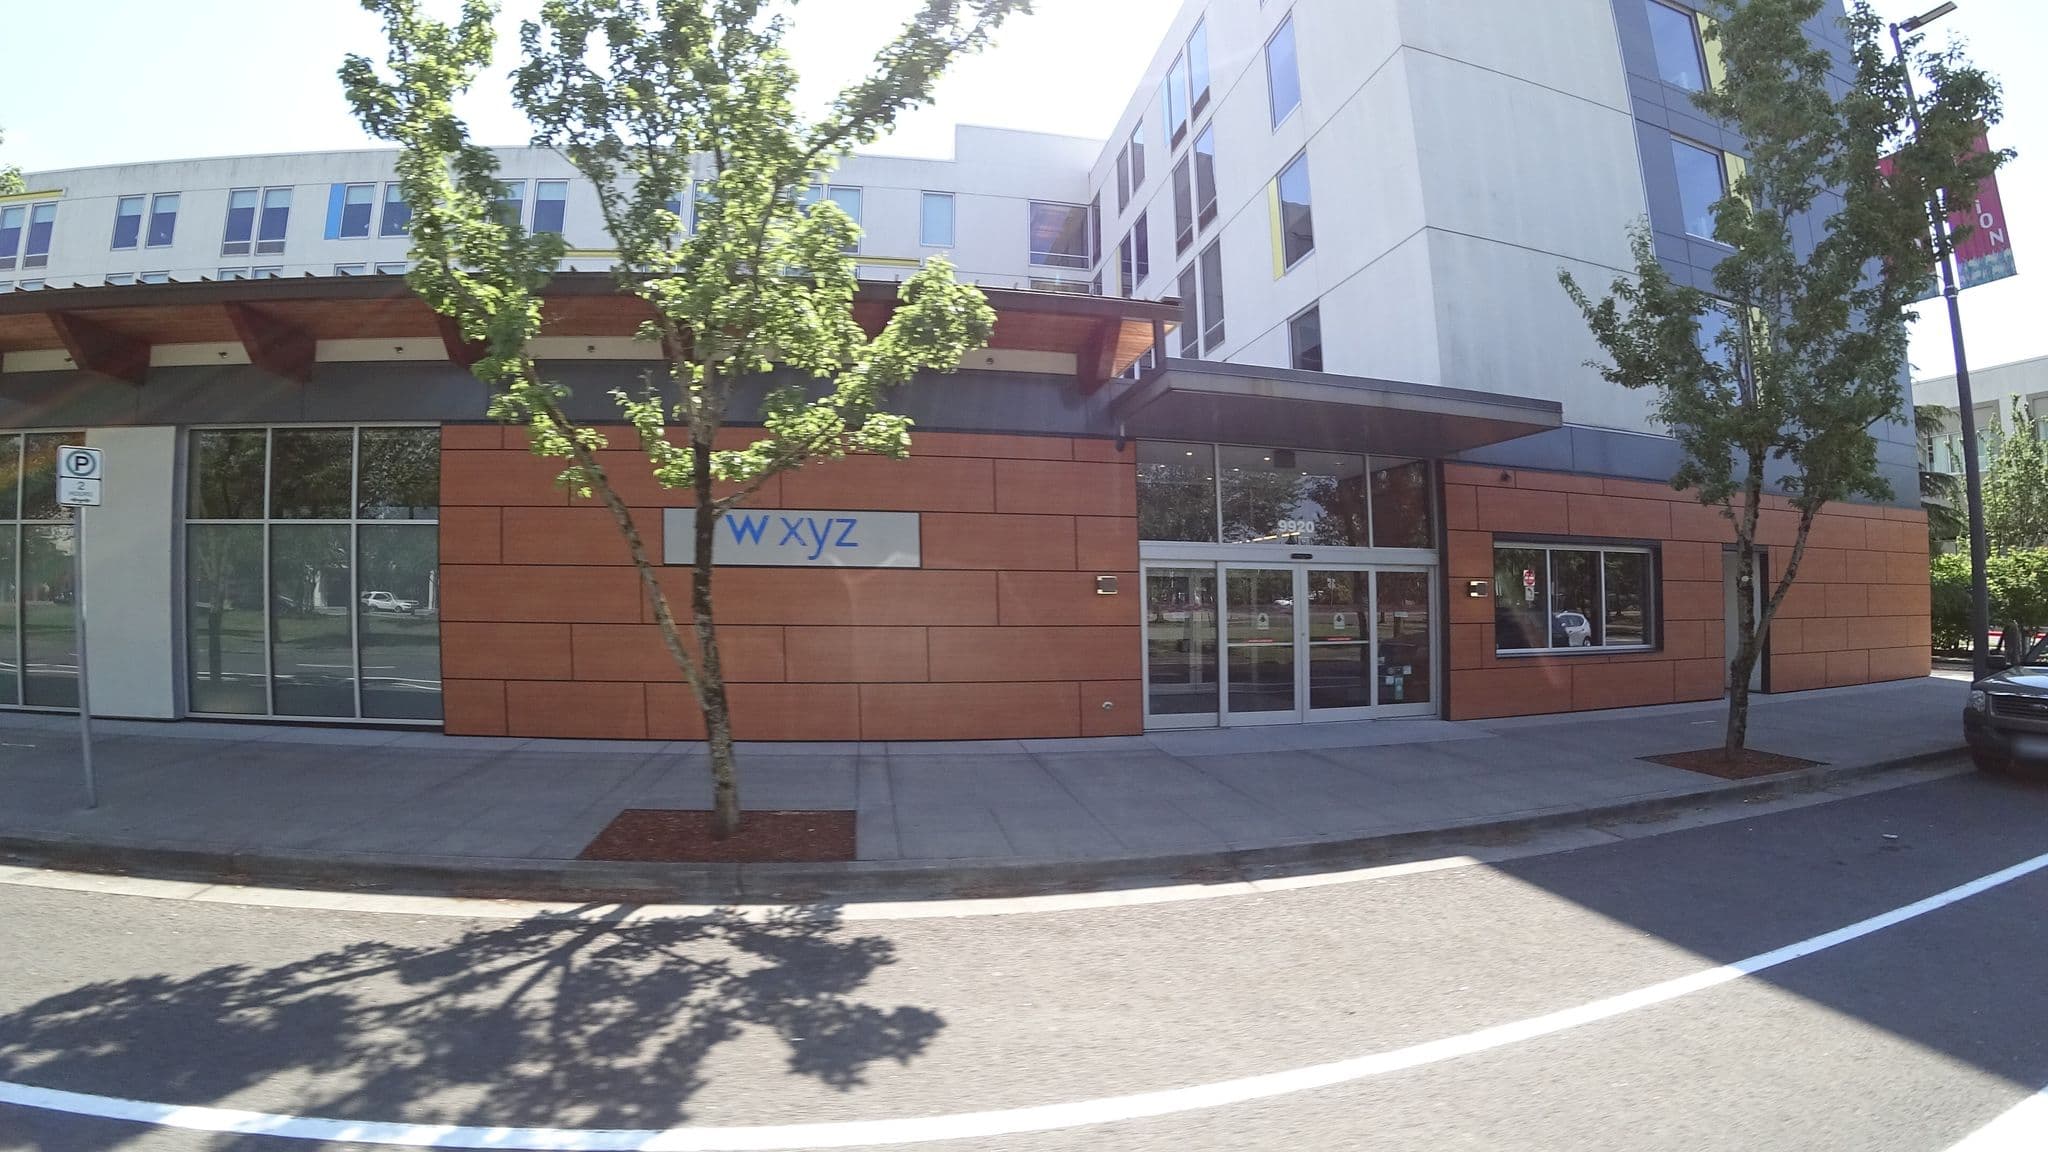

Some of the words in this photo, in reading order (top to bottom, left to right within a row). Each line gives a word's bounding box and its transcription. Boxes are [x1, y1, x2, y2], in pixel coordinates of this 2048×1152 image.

[75, 456, 89, 471] P
[77, 481, 85, 490] 2
[1278, 520, 1315, 533] 9920
